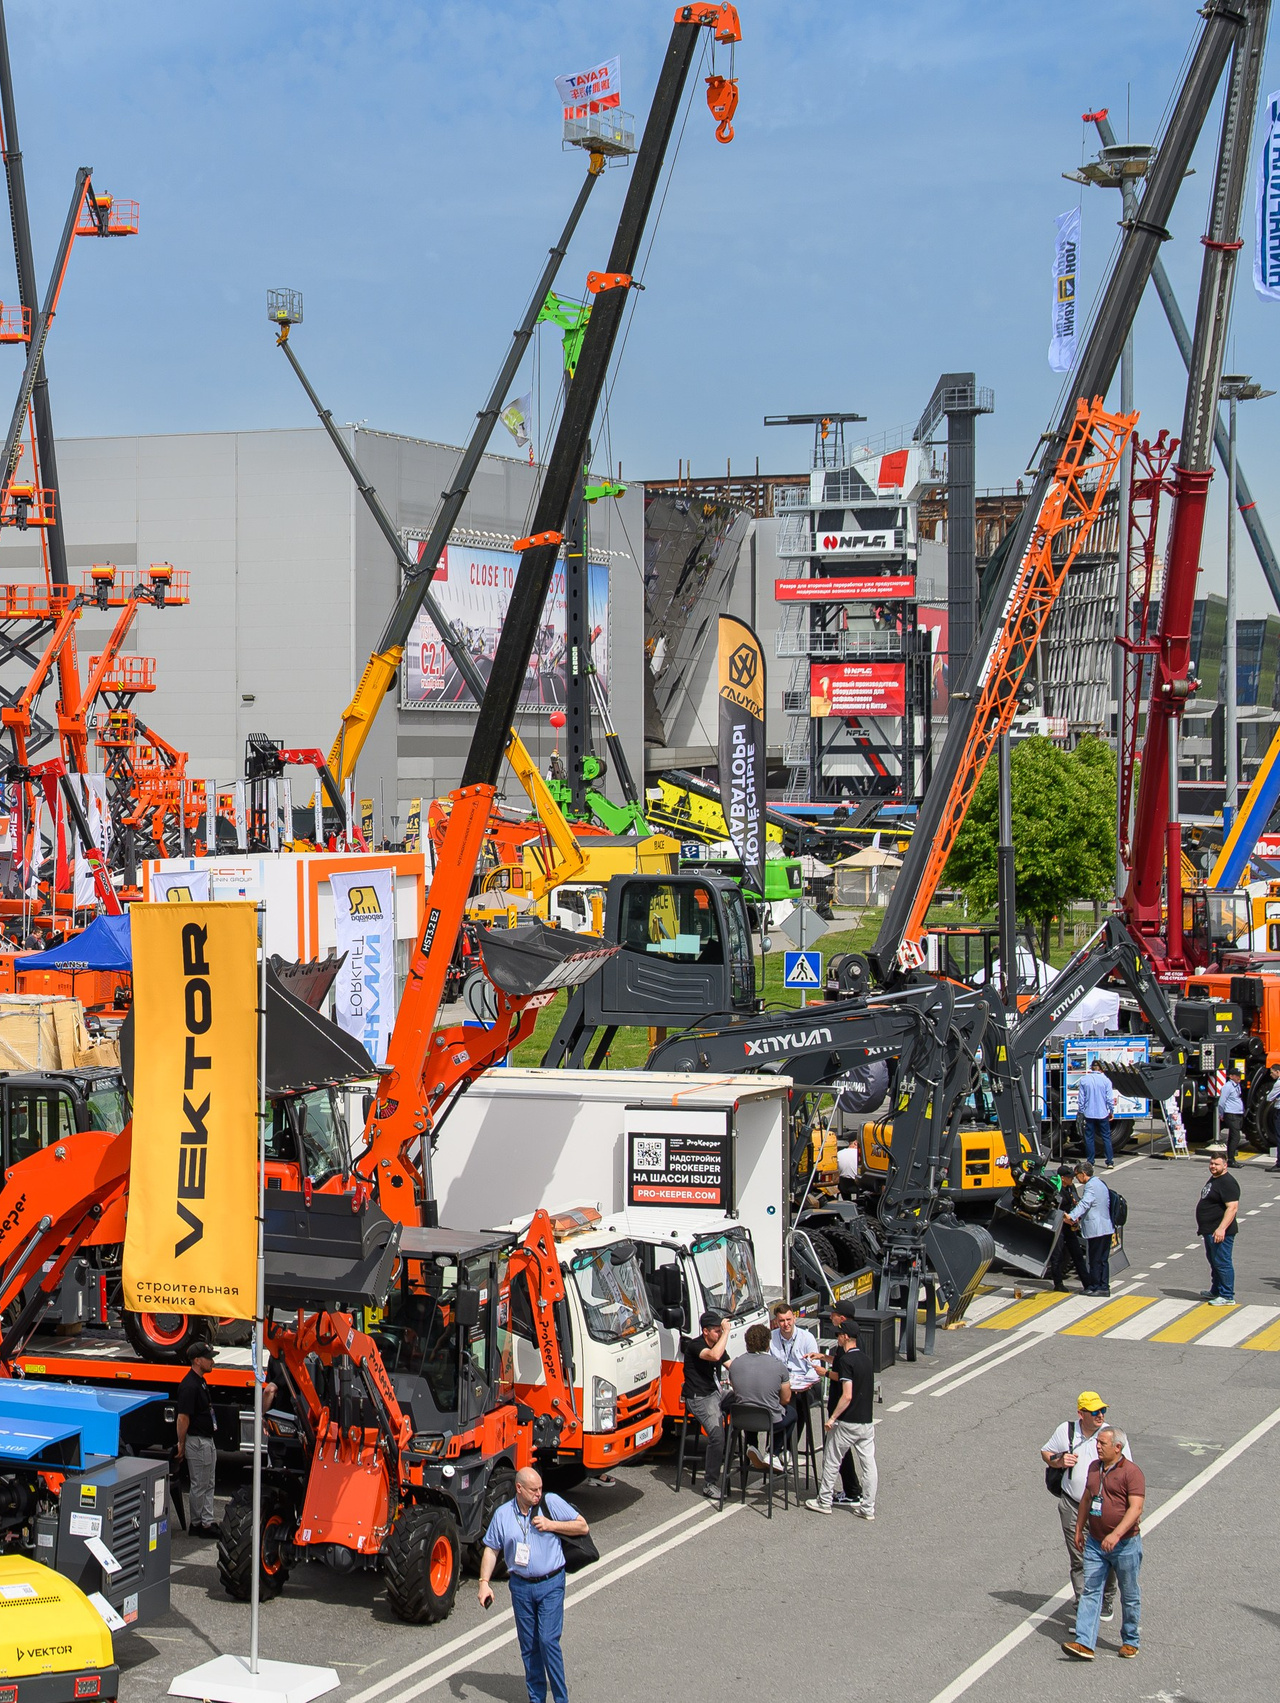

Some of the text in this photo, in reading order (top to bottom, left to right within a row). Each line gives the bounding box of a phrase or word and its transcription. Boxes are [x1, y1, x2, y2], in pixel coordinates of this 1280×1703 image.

[1064, 301, 1075, 337] КВИНТ
[839, 535, 886, 548] NFLG
[470, 562, 514, 589] CLOSE TO
[421, 642, 446, 676] C2.1
[422, 911, 439, 952] HST3.2 E2
[55, 961, 89, 969] VANSE
[410, 959, 428, 991] HYVA
[174, 922, 212, 1258] VEKTOR
[686, 1139, 721, 1148] ProKeeper
[670, 1155, 721, 1163] НАДСТРОЙКИ
[670, 1164, 721, 1172] PROKEEPER
[633, 1173, 721, 1184] НА ШАССИ ISUZU
[638, 1189, 716, 1199] PRO-KEEPER.COM
[136, 1281, 239, 1297] строительная
[137, 1294, 196, 1307] техника
[539, 1319, 557, 1379] ProKeeper
[634, 1371, 648, 1384] ISUZU
[27, 1645, 73, 1658] VEKTOR
